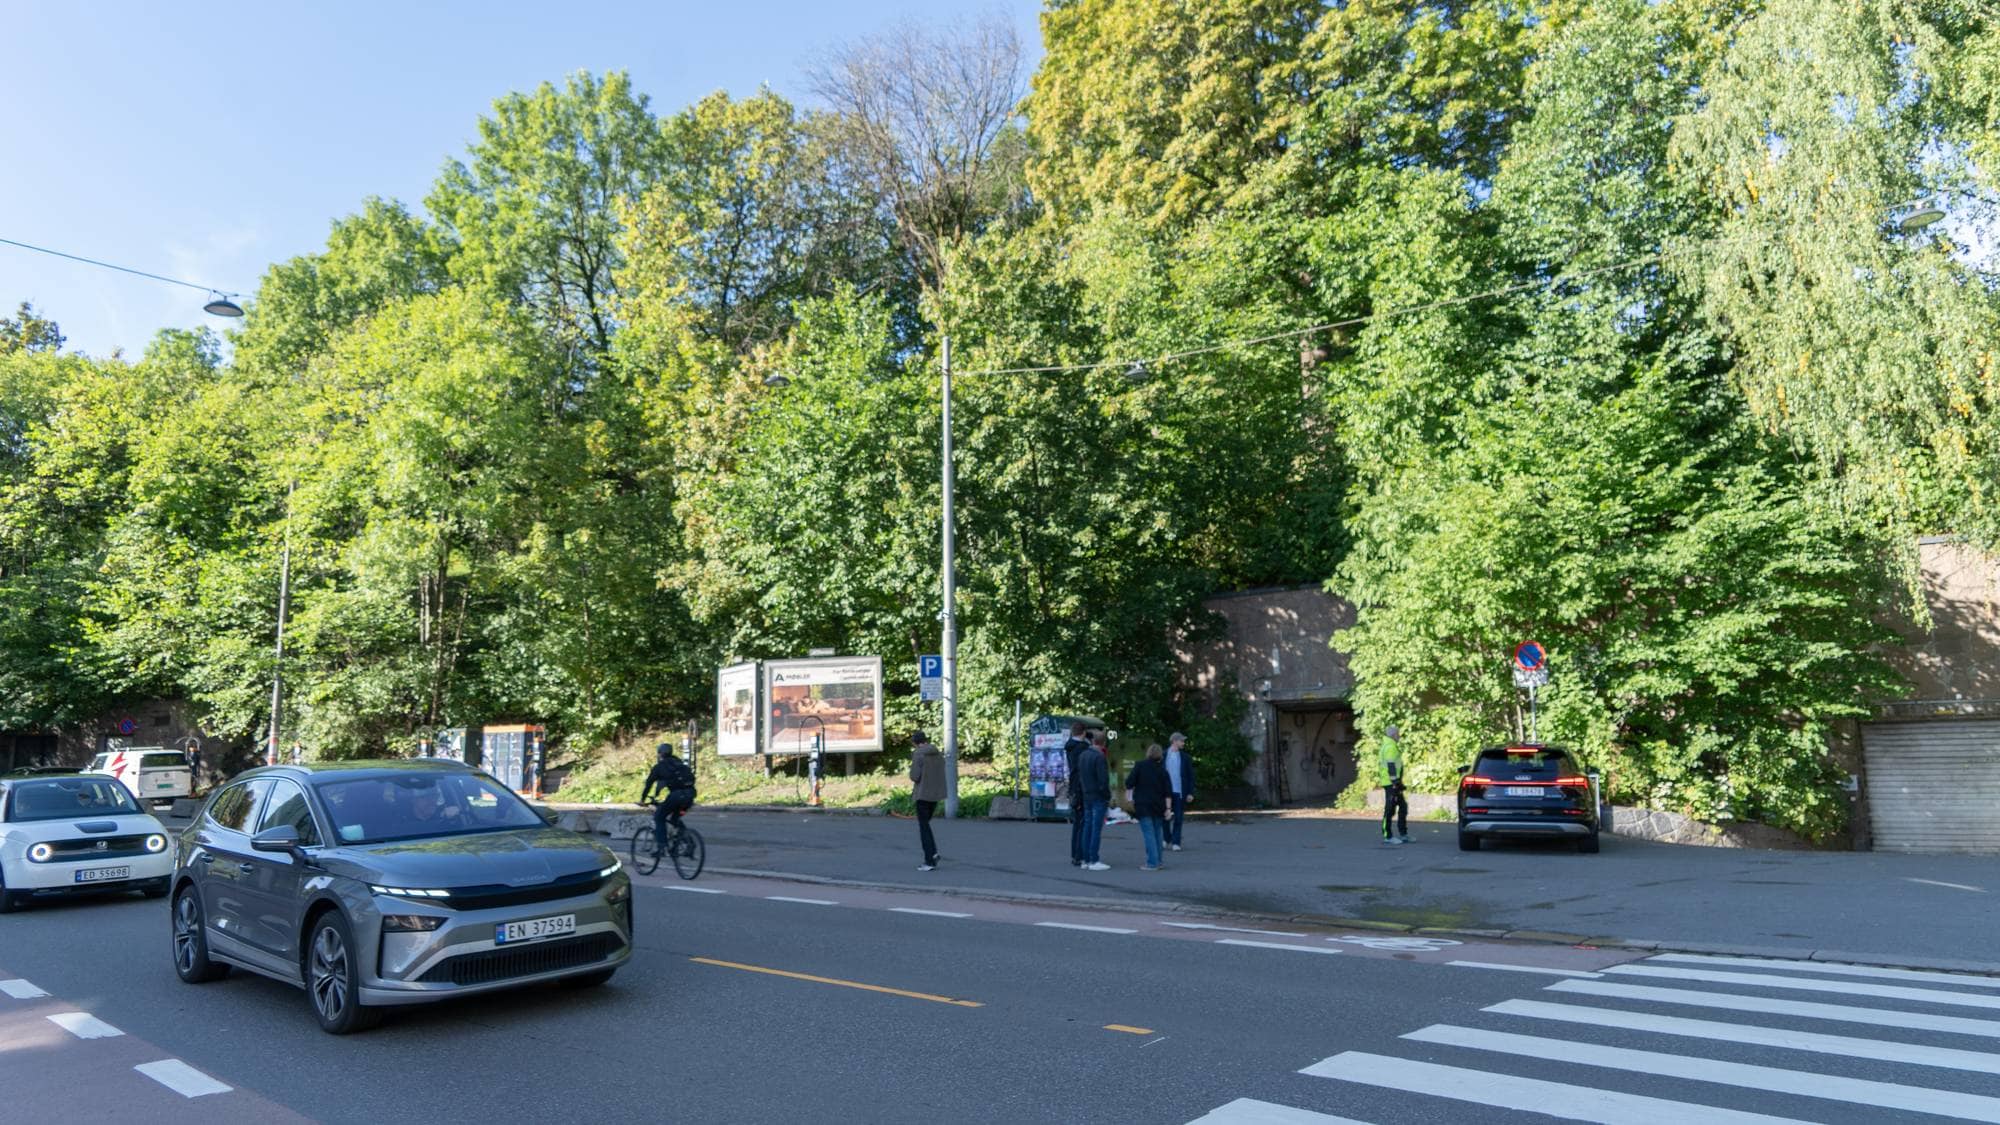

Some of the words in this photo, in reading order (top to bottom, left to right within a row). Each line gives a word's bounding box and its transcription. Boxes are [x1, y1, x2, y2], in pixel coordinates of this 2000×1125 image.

[926, 658, 937, 676] P
[84, 871, 95, 880] ED
[508, 924, 526, 938] EN
[533, 917, 572, 935] 37594
